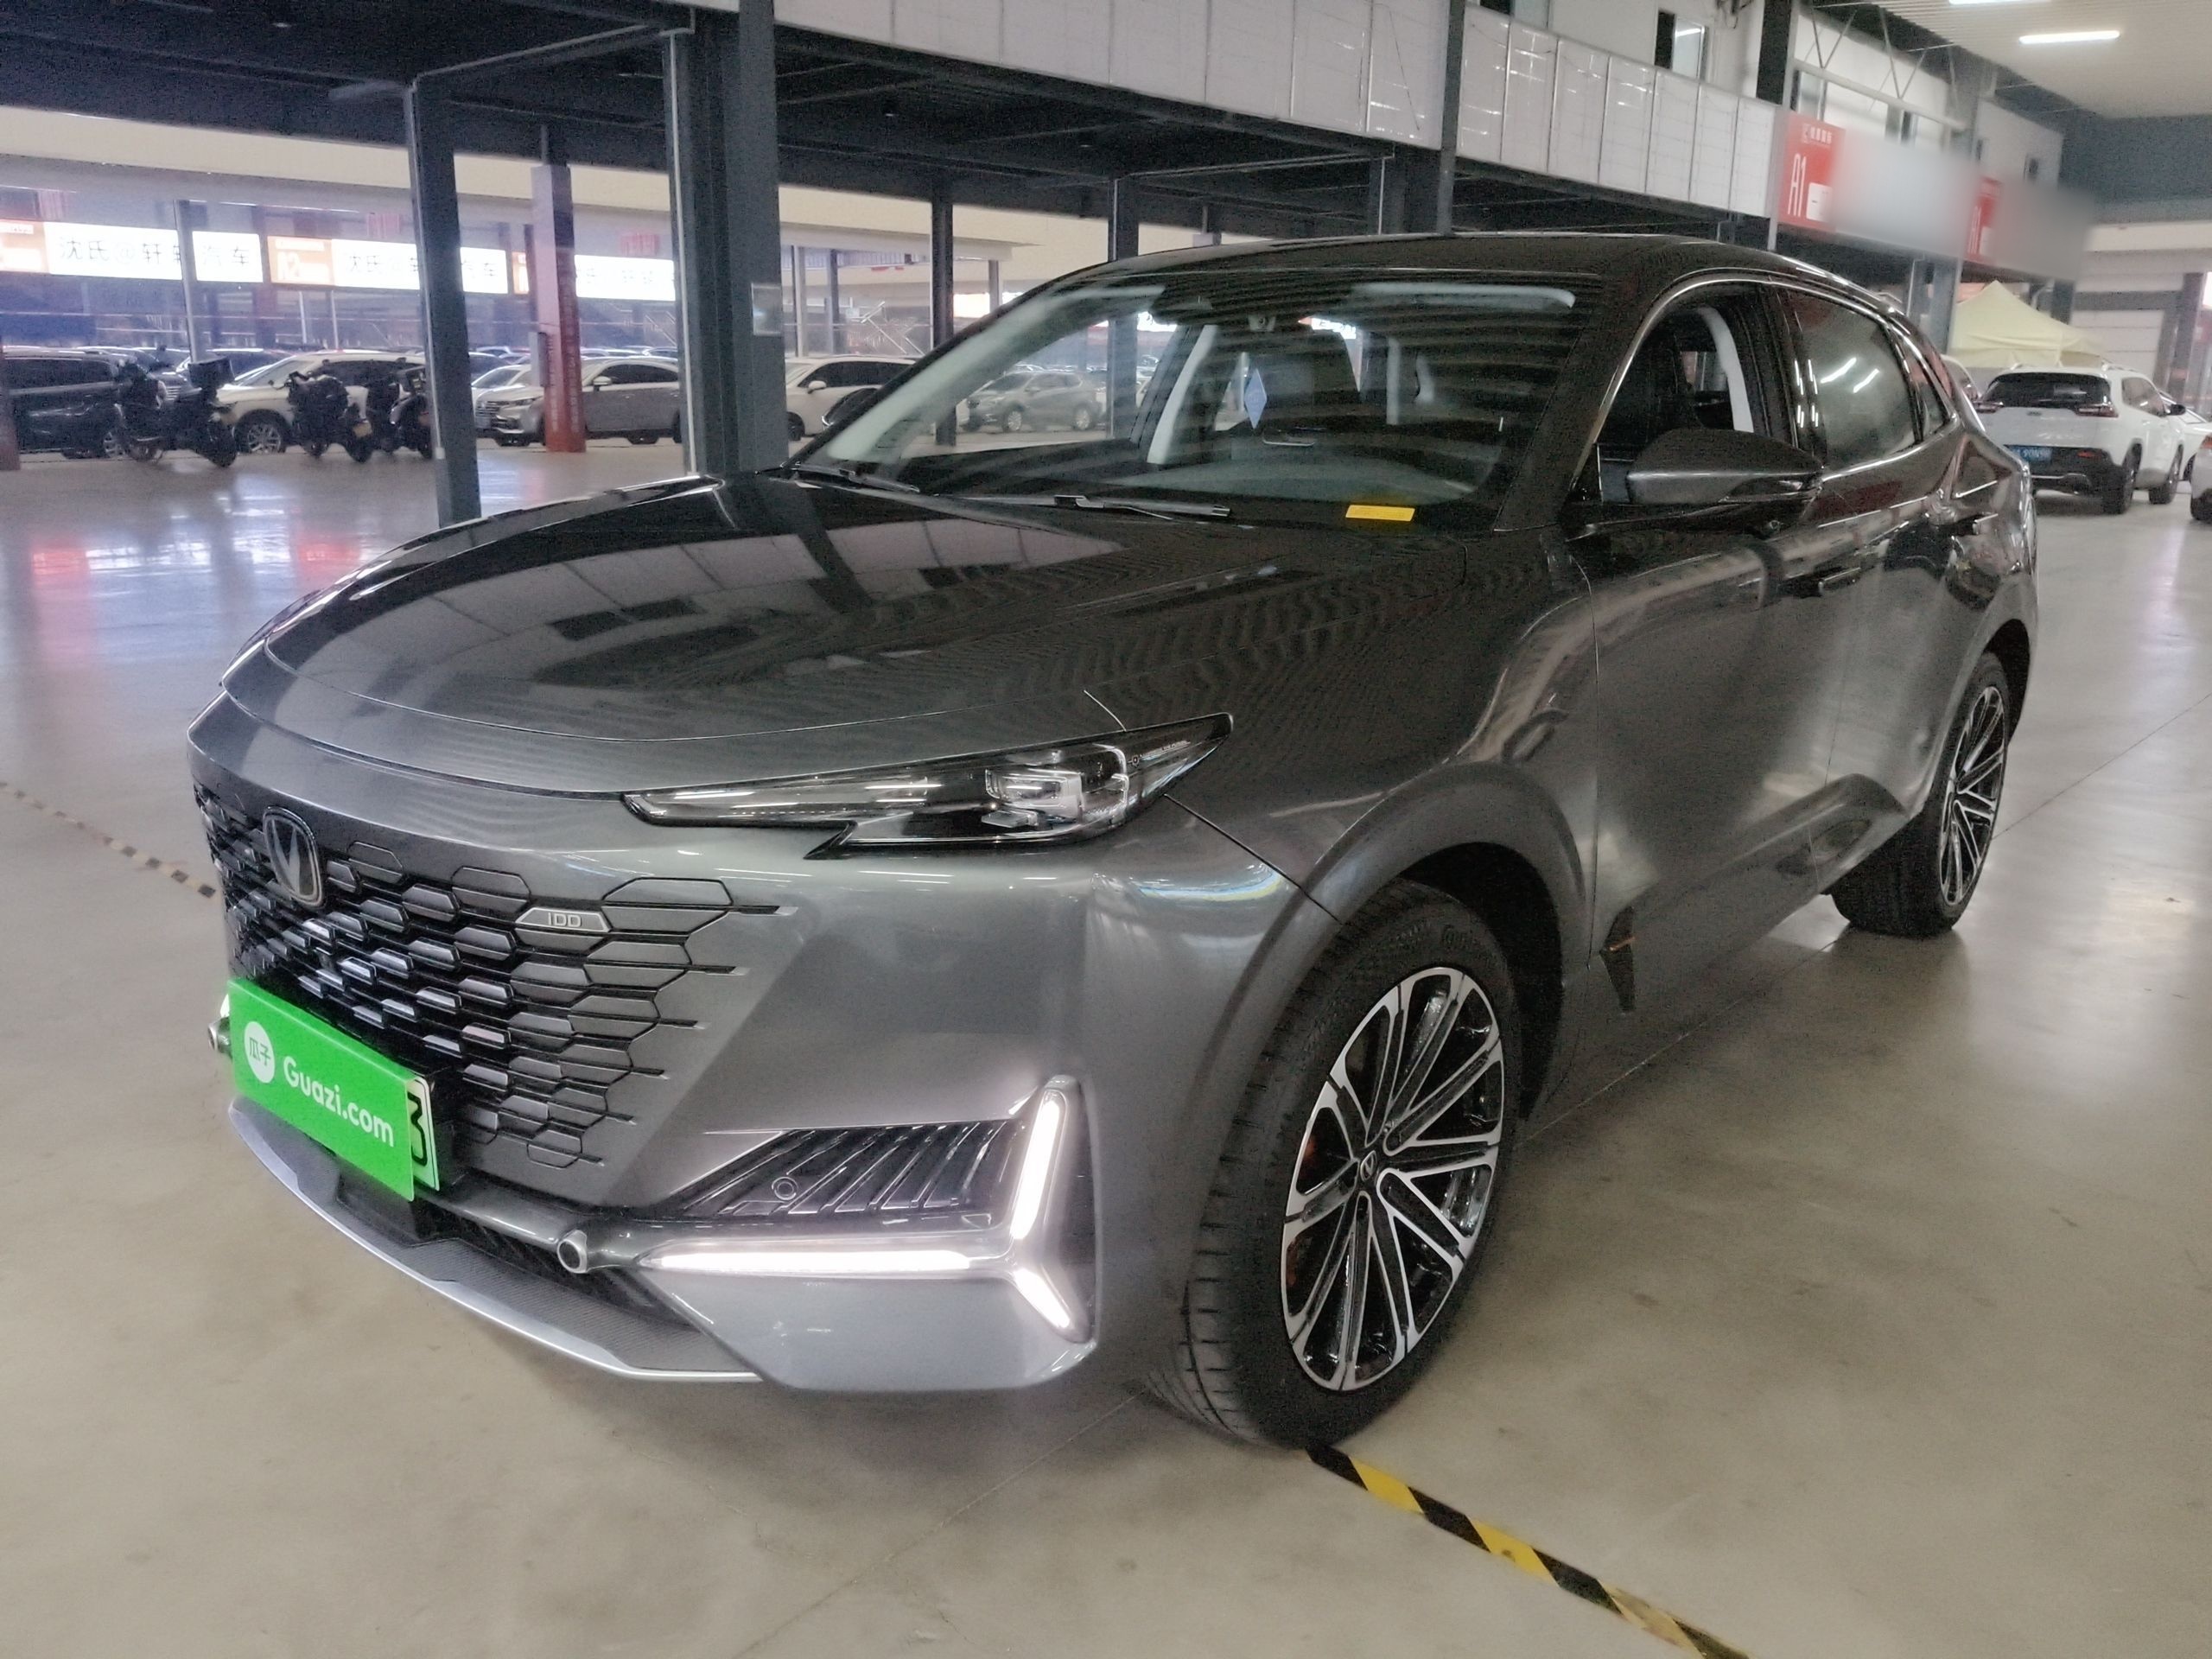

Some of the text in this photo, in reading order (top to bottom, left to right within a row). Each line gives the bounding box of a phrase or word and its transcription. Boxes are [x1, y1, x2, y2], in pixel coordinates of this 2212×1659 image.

[547, 912, 582, 928] IDD
[248, 1035, 272, 1069] 瓜子
[283, 1055, 395, 1147] Guazi.com
